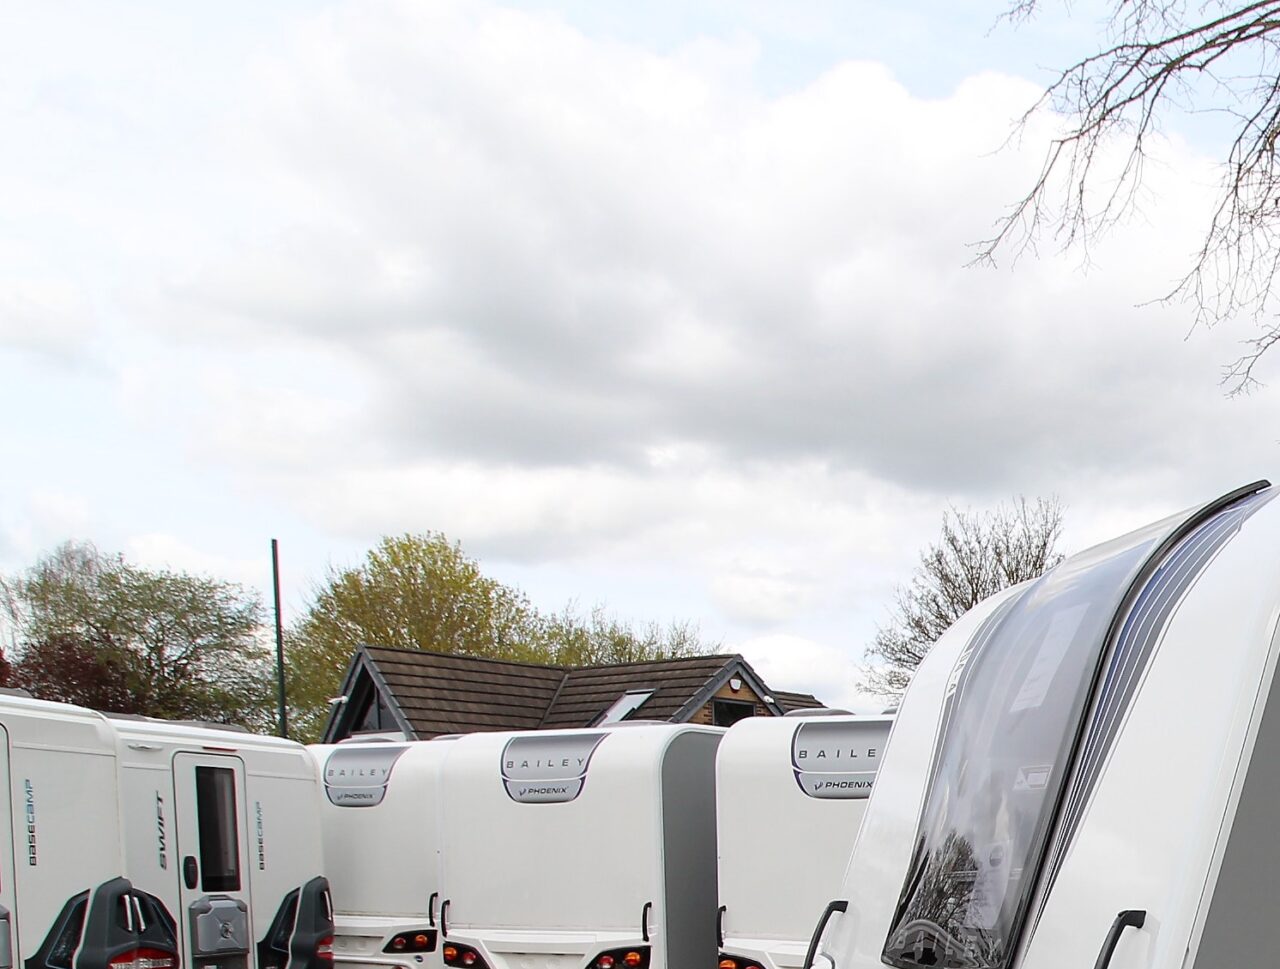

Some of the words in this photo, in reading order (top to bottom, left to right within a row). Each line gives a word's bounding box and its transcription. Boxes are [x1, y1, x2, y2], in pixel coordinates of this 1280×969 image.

[798, 748, 876, 758] BAILE
[506, 758, 584, 769] BAILEY
[327, 768, 387, 777] BAILEY
[825, 781, 873, 789] PHOENIX
[528, 787, 567, 795] PHOENIX
[156, 790, 167, 870] SWIFT
